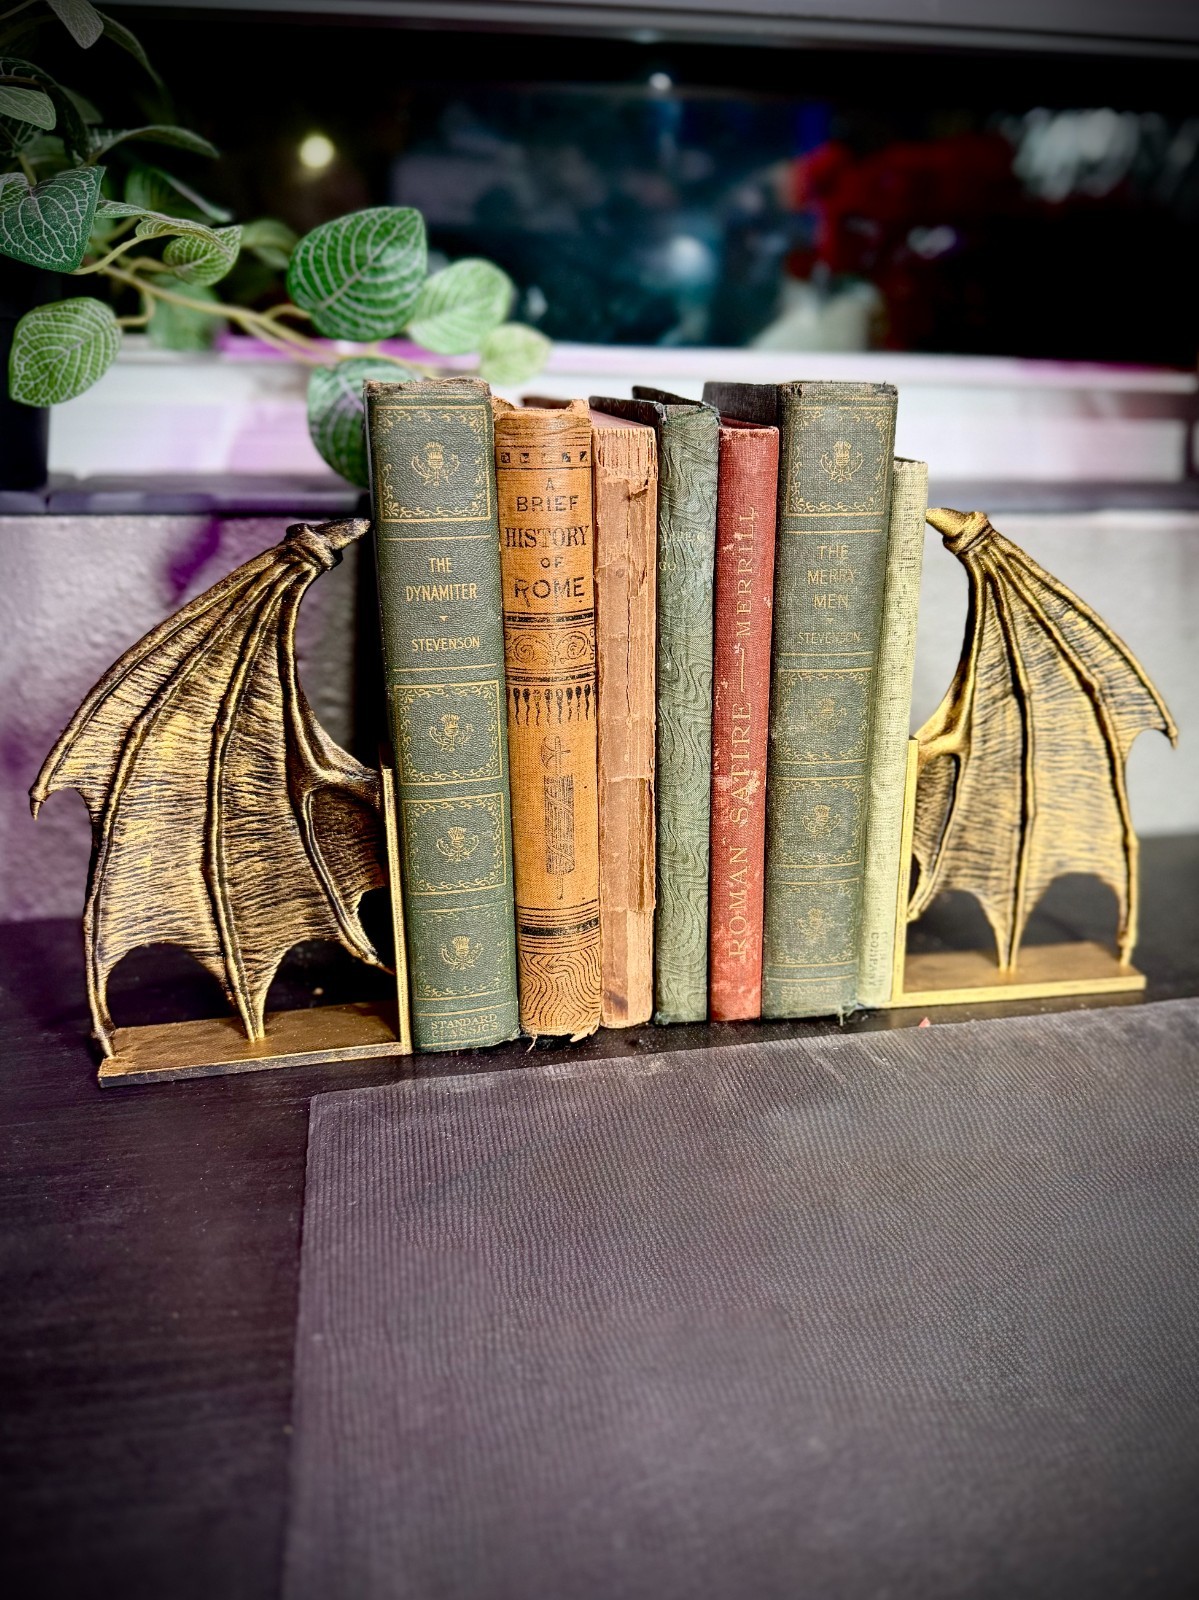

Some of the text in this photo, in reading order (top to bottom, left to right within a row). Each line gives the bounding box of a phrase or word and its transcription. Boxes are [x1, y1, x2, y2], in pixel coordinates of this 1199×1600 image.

[545, 478, 556, 491] A
[516, 495, 579, 512] BRIEF
[505, 526, 589, 548] HISTORY
[818, 545, 849, 560] THE
[429, 558, 453, 573] THE
[541, 557, 564, 568] OF
[736, 506, 759, 639] MERRILL
[405, 583, 478, 602] DYNAMITER
[514, 576, 586, 606] ROME
[813, 593, 849, 610] MEN
[411, 636, 480, 652] STEVENSON
[798, 631, 862, 645] STEVENSON
[729, 702, 752, 959] ROMAN SATIRE
[431, 1013, 498, 1030] STANDARD
[431, 1021, 499, 1039] CLASSICS
